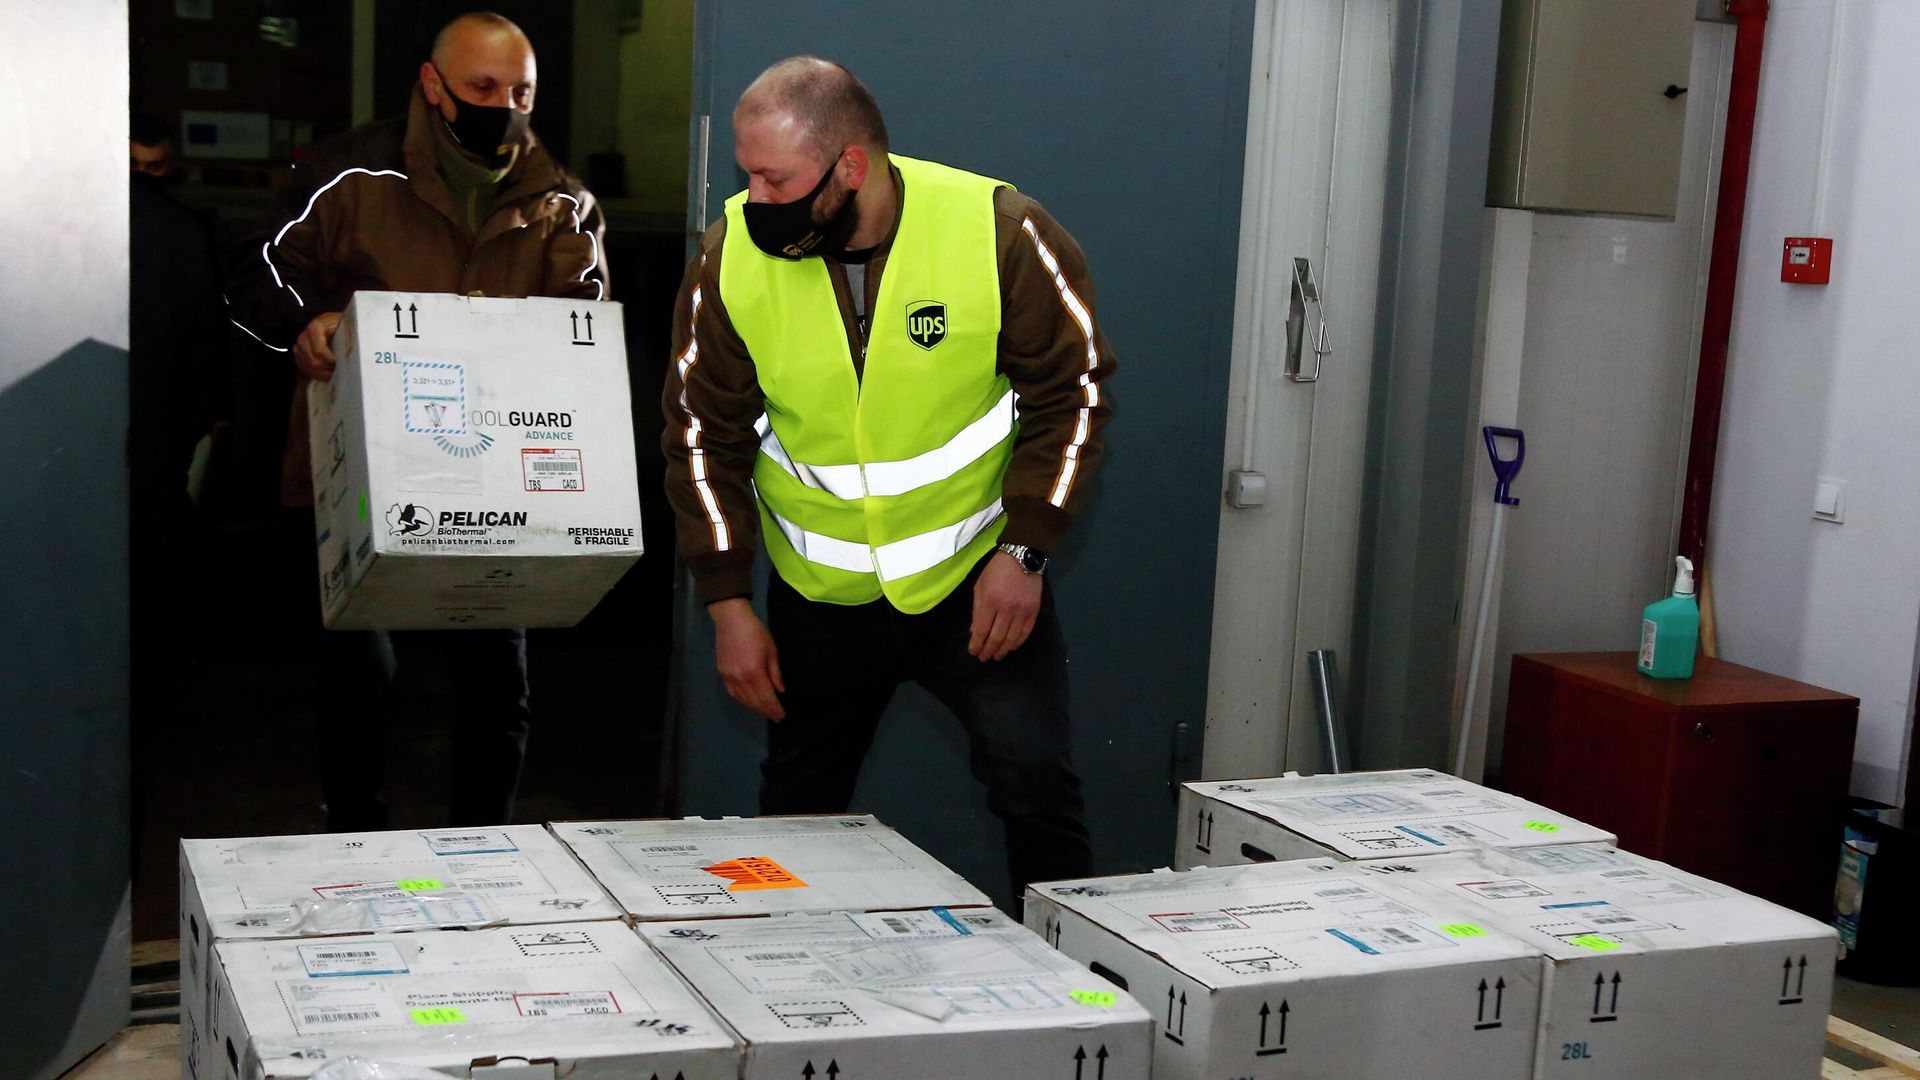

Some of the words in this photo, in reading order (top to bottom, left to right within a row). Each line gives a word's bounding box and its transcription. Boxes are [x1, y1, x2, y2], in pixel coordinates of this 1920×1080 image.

[910, 316, 945, 343] ups
[374, 351, 402, 364] 28L
[469, 410, 572, 428] OOLGUARD
[525, 430, 574, 441] ADVANCE
[438, 511, 527, 527] PELICAN
[567, 527, 633, 537] PERISHABLE
[401, 537, 516, 546] pelicanbiothermal.com
[574, 536, 582, 545] &
[585, 536, 629, 545] FRAGILE
[406, 997, 489, 1007] Documents
[1561, 1043, 1591, 1061] 28L
